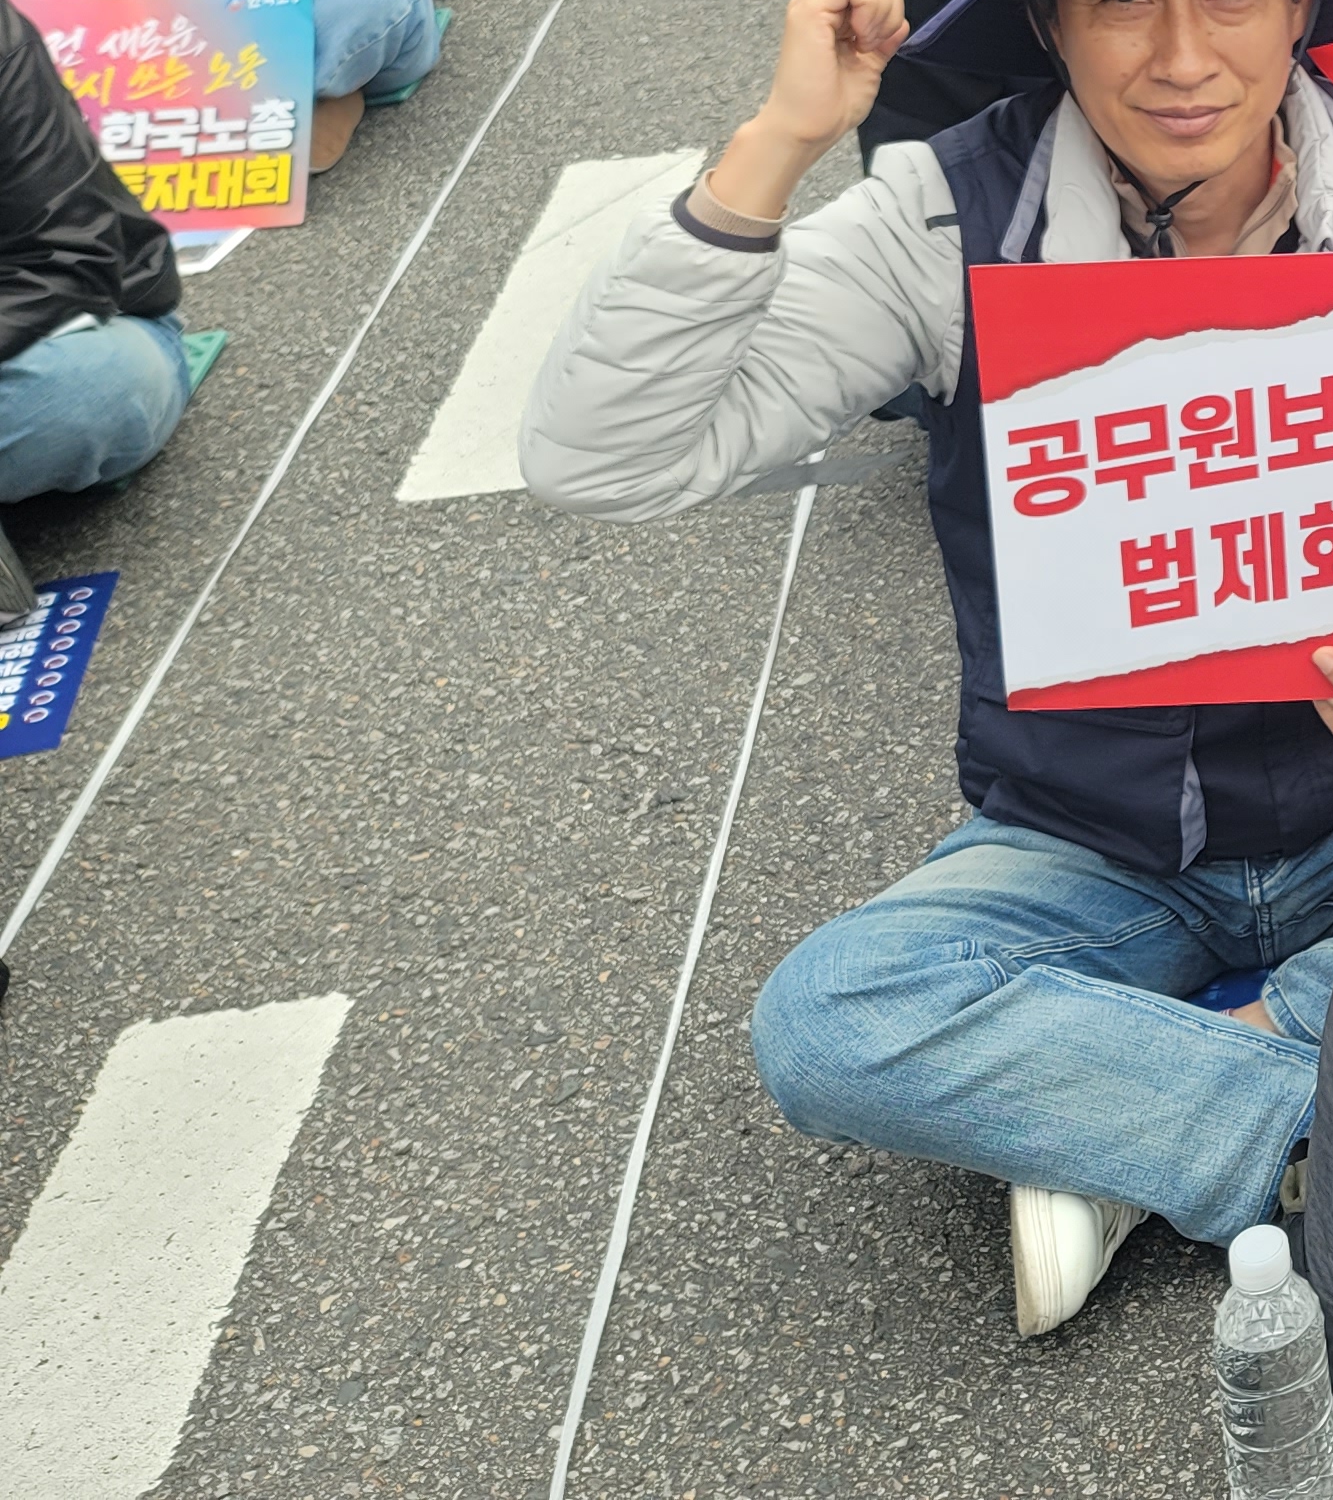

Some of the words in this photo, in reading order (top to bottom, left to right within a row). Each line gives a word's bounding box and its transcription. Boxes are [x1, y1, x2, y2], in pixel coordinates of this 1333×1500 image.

[126, 56, 195, 100] 쓰는
[204, 43, 268, 95] 노동
[100, 98, 297, 162] 한국노총
